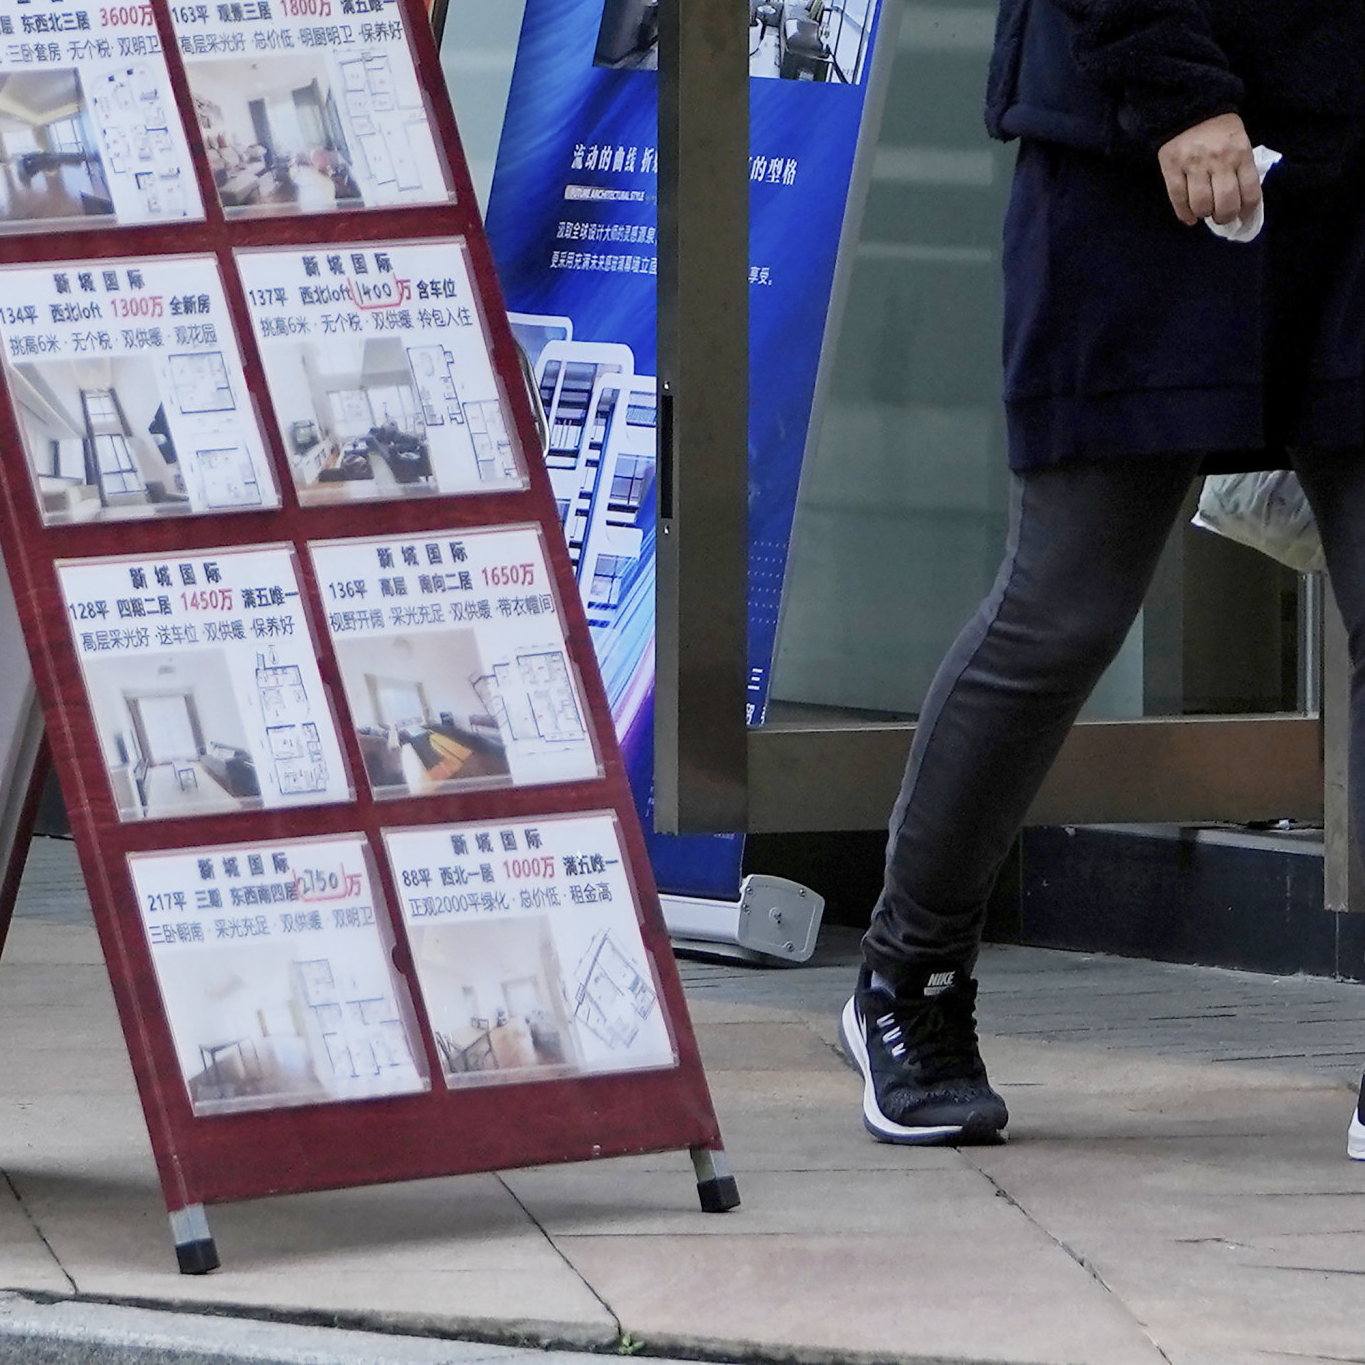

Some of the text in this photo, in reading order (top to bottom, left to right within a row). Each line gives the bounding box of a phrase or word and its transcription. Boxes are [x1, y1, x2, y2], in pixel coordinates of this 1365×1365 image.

[20, 11, 91, 35] 东西北三居
[99, 4, 156, 27] 3600万
[173, 4, 210, 25] 163平
[116, 35, 162, 56] 双明卫
[180, 34, 247, 56] 高层采光好
[361, 21, 403, 43] 保养好
[571, 143, 638, 173] 流动的曲线
[748, 155, 798, 185] 的型格
[302, 252, 393, 277] 新城国际
[249, 288, 289, 307] 137平
[299, 284, 352, 306] 西北loft
[416, 278, 457, 301] 含车位
[50, 301, 103, 324] 西北loft
[110, 296, 164, 319] 1300万
[169, 294, 211, 316] 全新房
[376, 541, 467, 569] 新城国际
[129, 562, 222, 590] 新城国际
[329, 563, 535, 600] 136平 高层 南向二居 1650万
[69, 586, 300, 620] 128平 四期二居 1450万 满五唯一
[80, 627, 150, 653] 高层采光好
[252, 616, 296, 638] 保养好
[451, 829, 542, 857] 新城国际
[402, 853, 619, 888] 88平 西北一居 1000万 满五唯一
[147, 892, 187, 912] 217平
[570, 882, 614, 905] 租金高
[928, 971, 955, 986] NIKE
